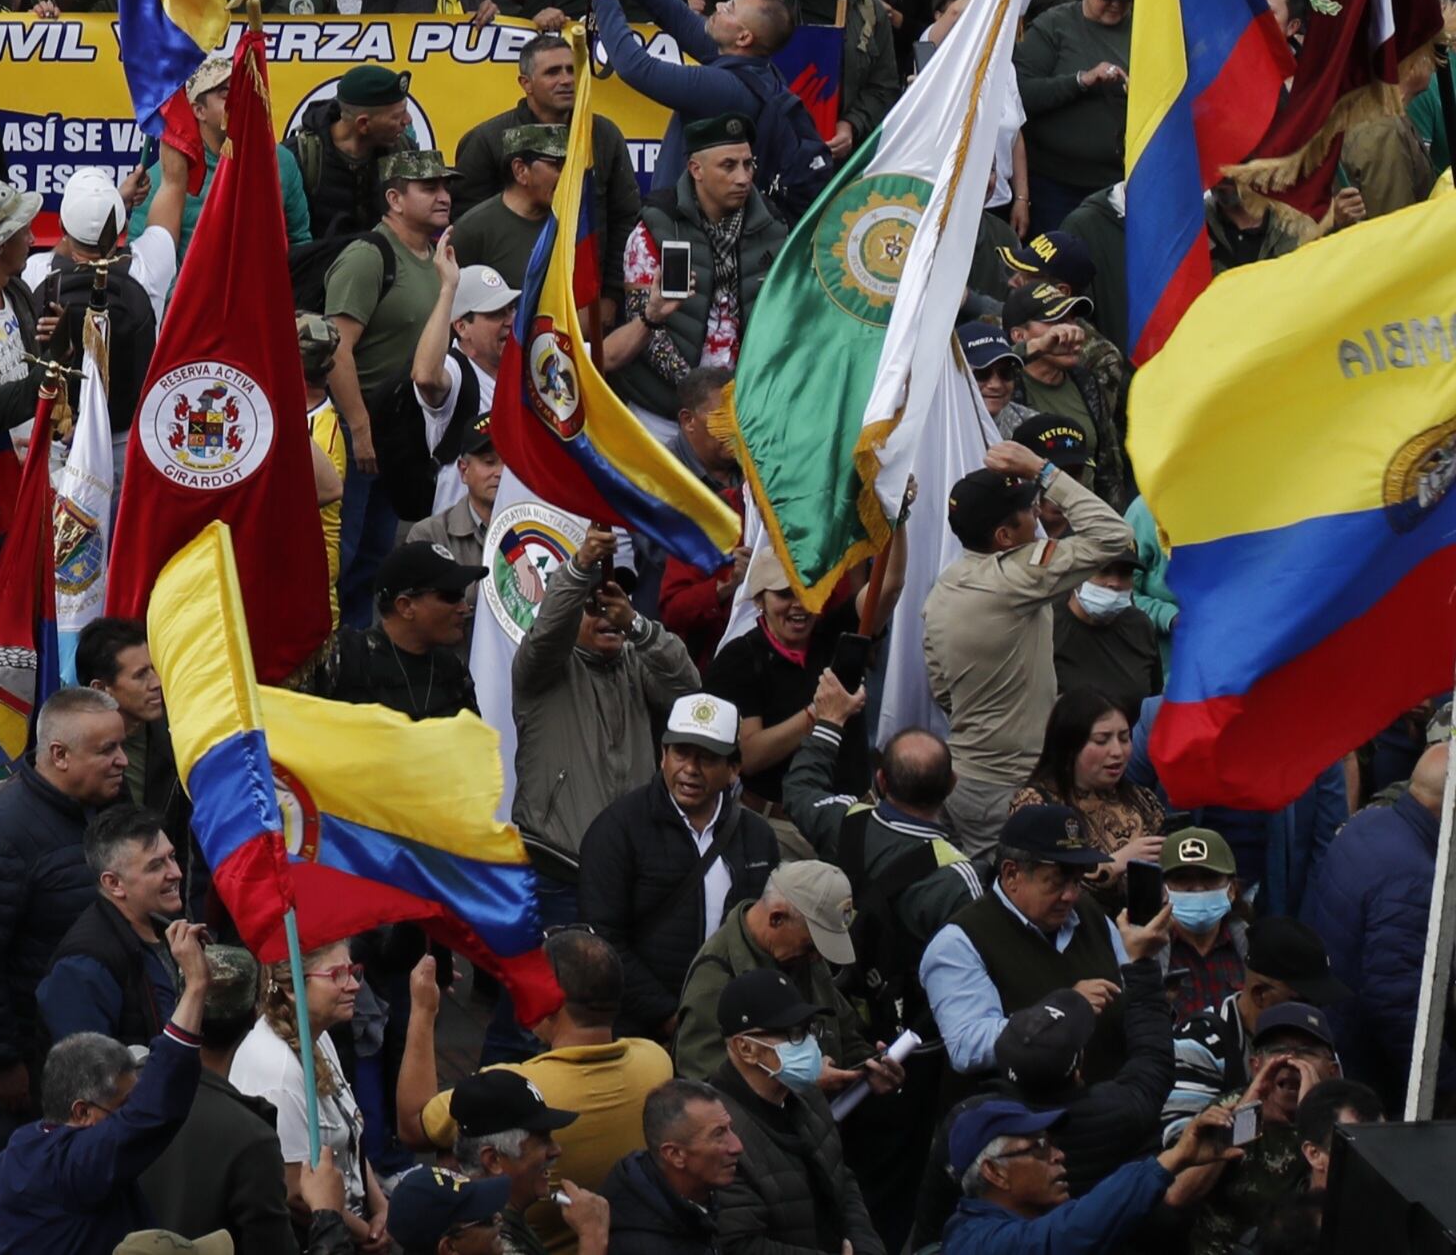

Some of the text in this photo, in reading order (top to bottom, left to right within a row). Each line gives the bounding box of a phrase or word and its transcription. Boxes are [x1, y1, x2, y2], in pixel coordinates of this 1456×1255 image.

[3, 118, 69, 154] ASÍ
[77, 123, 114, 154] SE
[968, 337, 994, 348] FUERZA
[159, 364, 257, 395] RESERVA ACTIVA
[1038, 427, 1083, 442] VETERANO
[163, 464, 244, 488] GIRARDOT
[489, 506, 585, 547] COOPERATIVA MULTIACTIV
[485, 579, 520, 640] COOMILITAR
